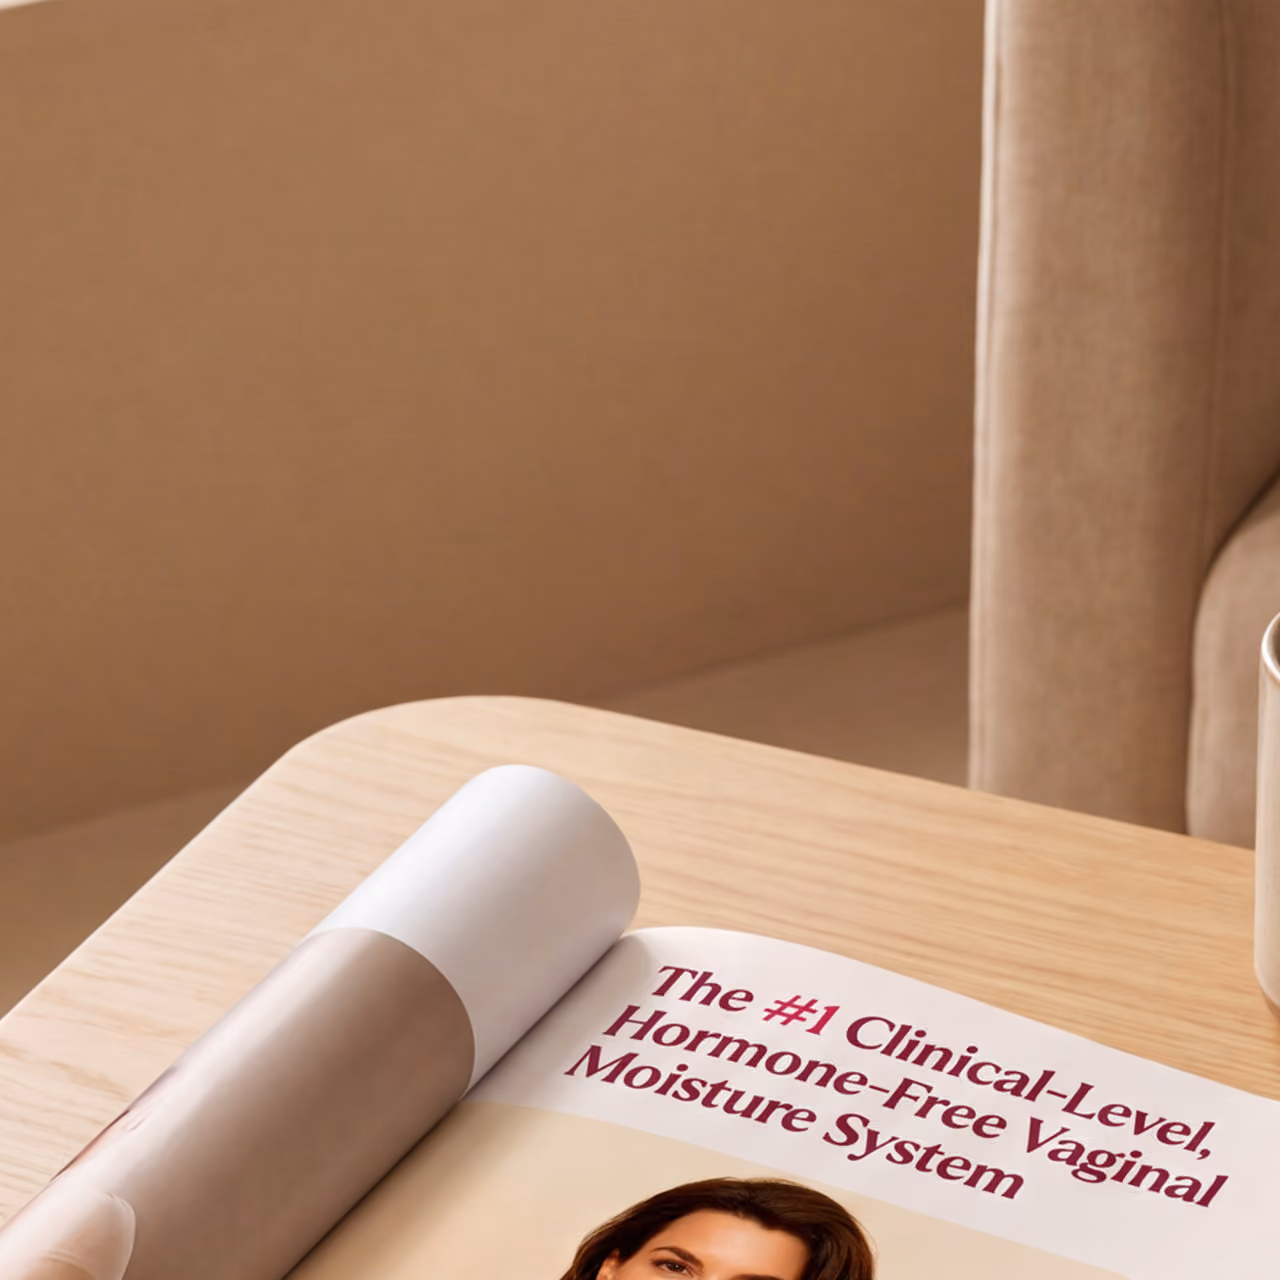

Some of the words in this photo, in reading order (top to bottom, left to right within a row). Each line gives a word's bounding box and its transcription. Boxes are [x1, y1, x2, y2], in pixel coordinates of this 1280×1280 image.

[563, 1045, 817, 1132] Moisture
[823, 1113, 1024, 1199] System
[602, 1004, 1007, 1138] Hormone-Free
[1027, 1116, 1228, 1207] Vaginal
[652, 966, 754, 1012] The
[763, 995, 840, 1035] #1
[846, 1016, 1215, 1160] Clinical-Level,
